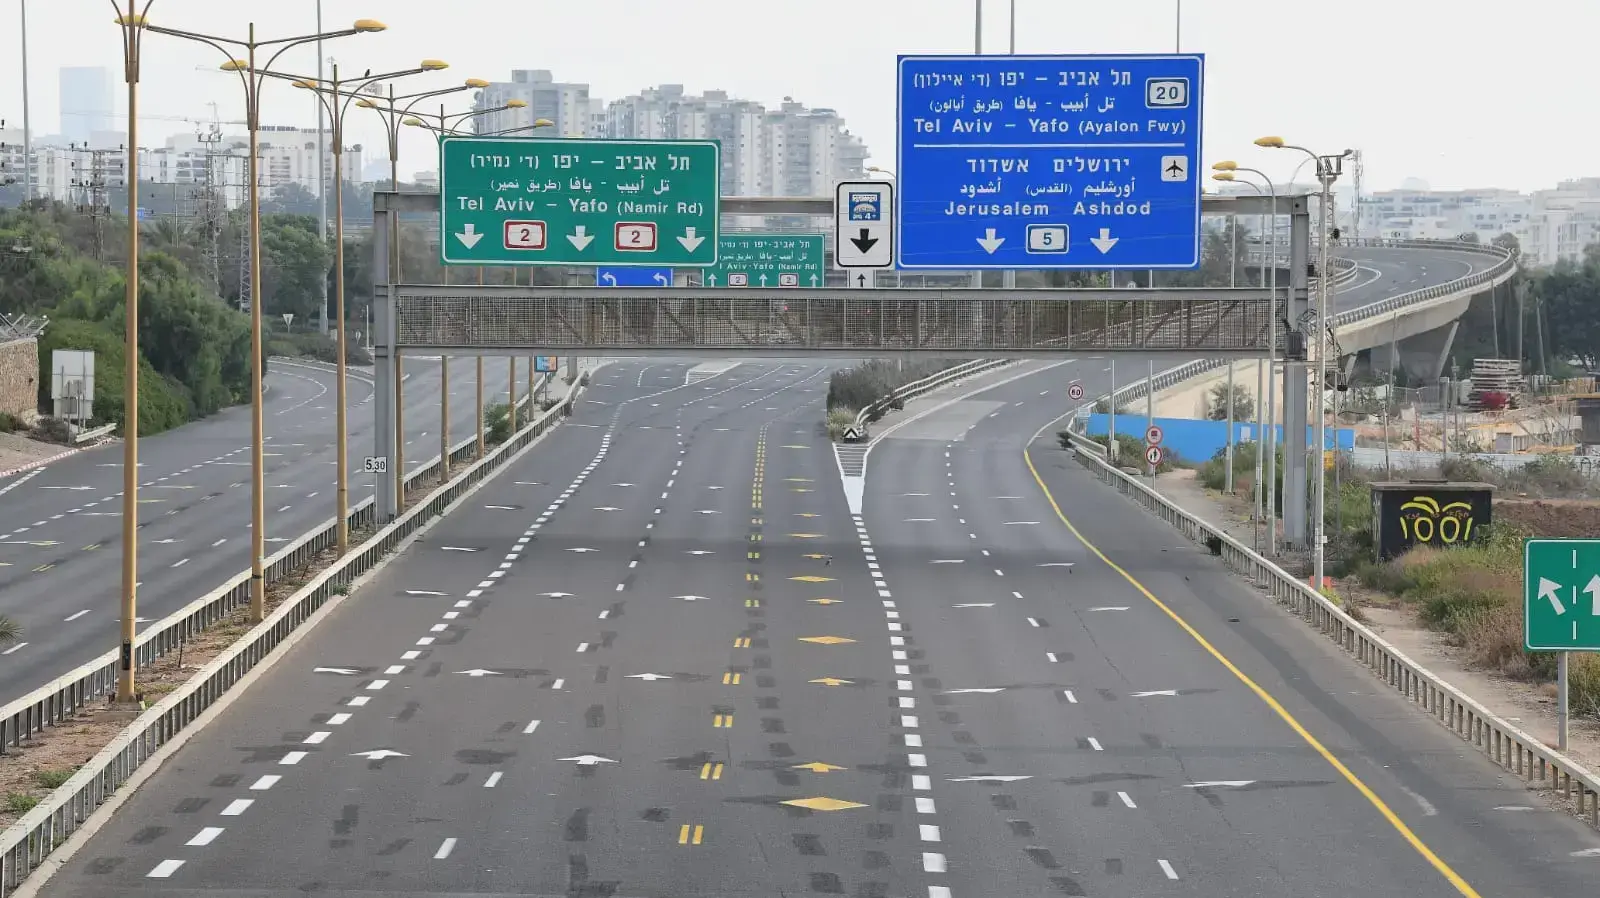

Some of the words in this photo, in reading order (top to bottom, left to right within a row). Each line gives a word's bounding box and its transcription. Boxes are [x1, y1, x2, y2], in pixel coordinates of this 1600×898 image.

[914, 72, 963, 88] איילון)
[1000, 71, 1025, 86] יפו
[1058, 70, 1100, 86] אביב
[1110, 68, 1131, 86] תל
[1155, 86, 1179, 100] 20
[929, 94, 965, 113] أيالون)
[973, 99, 1003, 113] (طريق
[1014, 95, 1037, 112] يافا
[1060, 93, 1089, 111] أبيب
[1097, 96, 1116, 113] تل
[913, 118, 940, 133] Tel
[951, 118, 993, 133] Aviv
[1028, 118, 1069, 133] Yafo
[1078, 119, 1139, 136] (Ayalon
[1148, 119, 1187, 136] Fwy)
[470, 153, 510, 168] נמיר)
[552, 154, 579, 169] יפו
[615, 155, 656, 170] אביב
[668, 153, 690, 171] תל
[966, 158, 1029, 173] אשדוד
[1053, 156, 1130, 173] ירושלים
[490, 179, 520, 192] نمير)
[526, 178, 561, 193] (طريق
[569, 176, 592, 193] يافا
[616, 174, 645, 194] أبيب
[653, 178, 670, 195] تل
[960, 176, 1002, 199] أشدود
[1025, 182, 1073, 197] (القدس)
[1083, 176, 1136, 198] أورشليم
[457, 196, 483, 210] Tel
[494, 196, 535, 212] Aviv
[568, 198, 608, 212] Yafo
[617, 201, 669, 215] (Namir
[677, 202, 704, 216] Rd)
[944, 200, 1050, 216] Jerusalem
[1073, 200, 1151, 216] Ashdod
[520, 228, 531, 242] 2
[631, 230, 641, 243] 2
[1042, 232, 1053, 246] 5
[719, 241, 736, 249] נמיר
[799, 240, 810, 249] תל
[735, 276, 741, 284] 2
[786, 276, 792, 284] 2
[366, 459, 386, 470] 5.30
